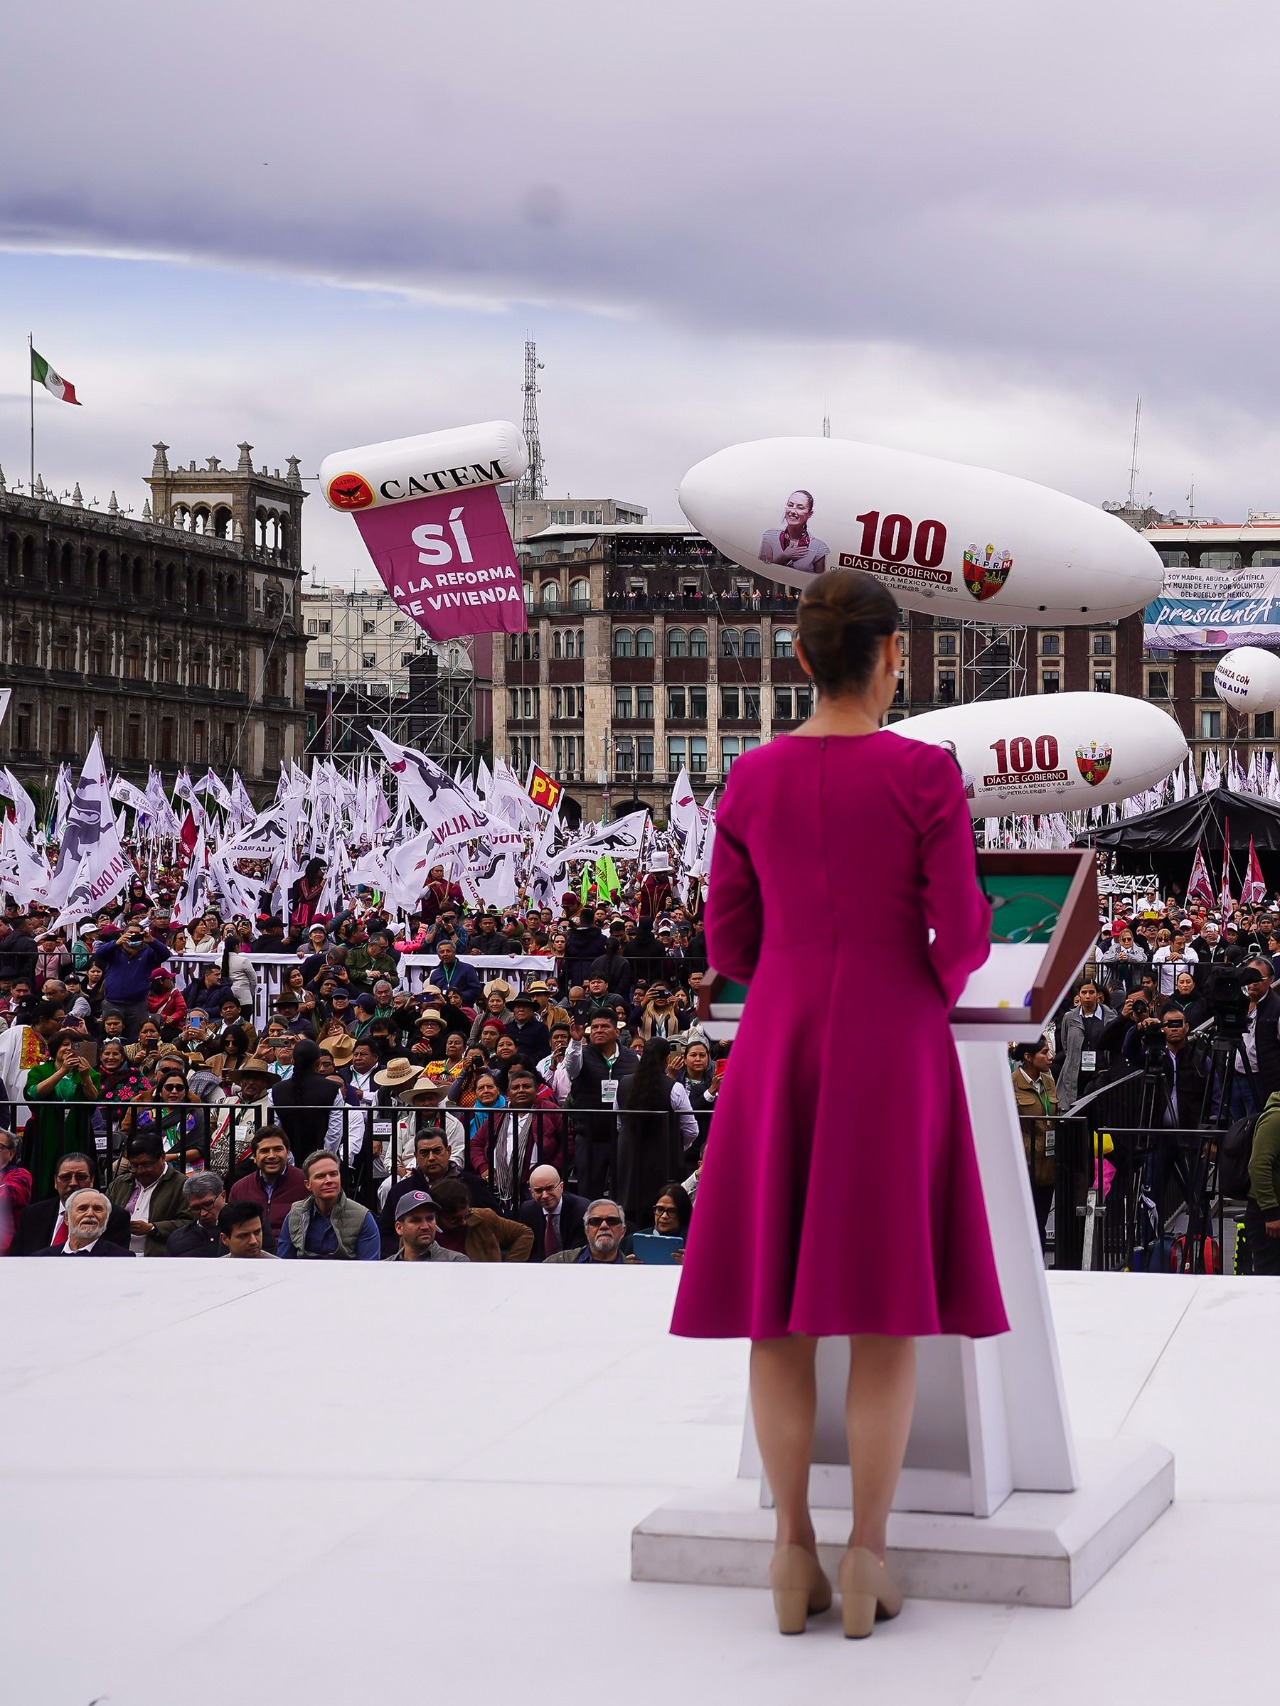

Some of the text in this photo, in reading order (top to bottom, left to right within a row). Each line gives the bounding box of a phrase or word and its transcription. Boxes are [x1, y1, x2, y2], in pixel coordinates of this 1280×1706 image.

[380, 459, 509, 500] CATEM
[412, 507, 473, 566] SÍ
[856, 510, 947, 568] 100
[393, 565, 516, 598] A LA REFORMA
[843, 556, 869, 570] DÍAS
[872, 561, 887, 573] DE
[889, 565, 948, 583] GOBIERNO
[898, 576, 926, 587] MÉXICO
[400, 586, 520, 617] DE VIVIENDA
[990, 735, 1059, 773] 100
[531, 775, 559, 806] PT
[987, 771, 1066, 785] DÍAS DE GOBIERNO
